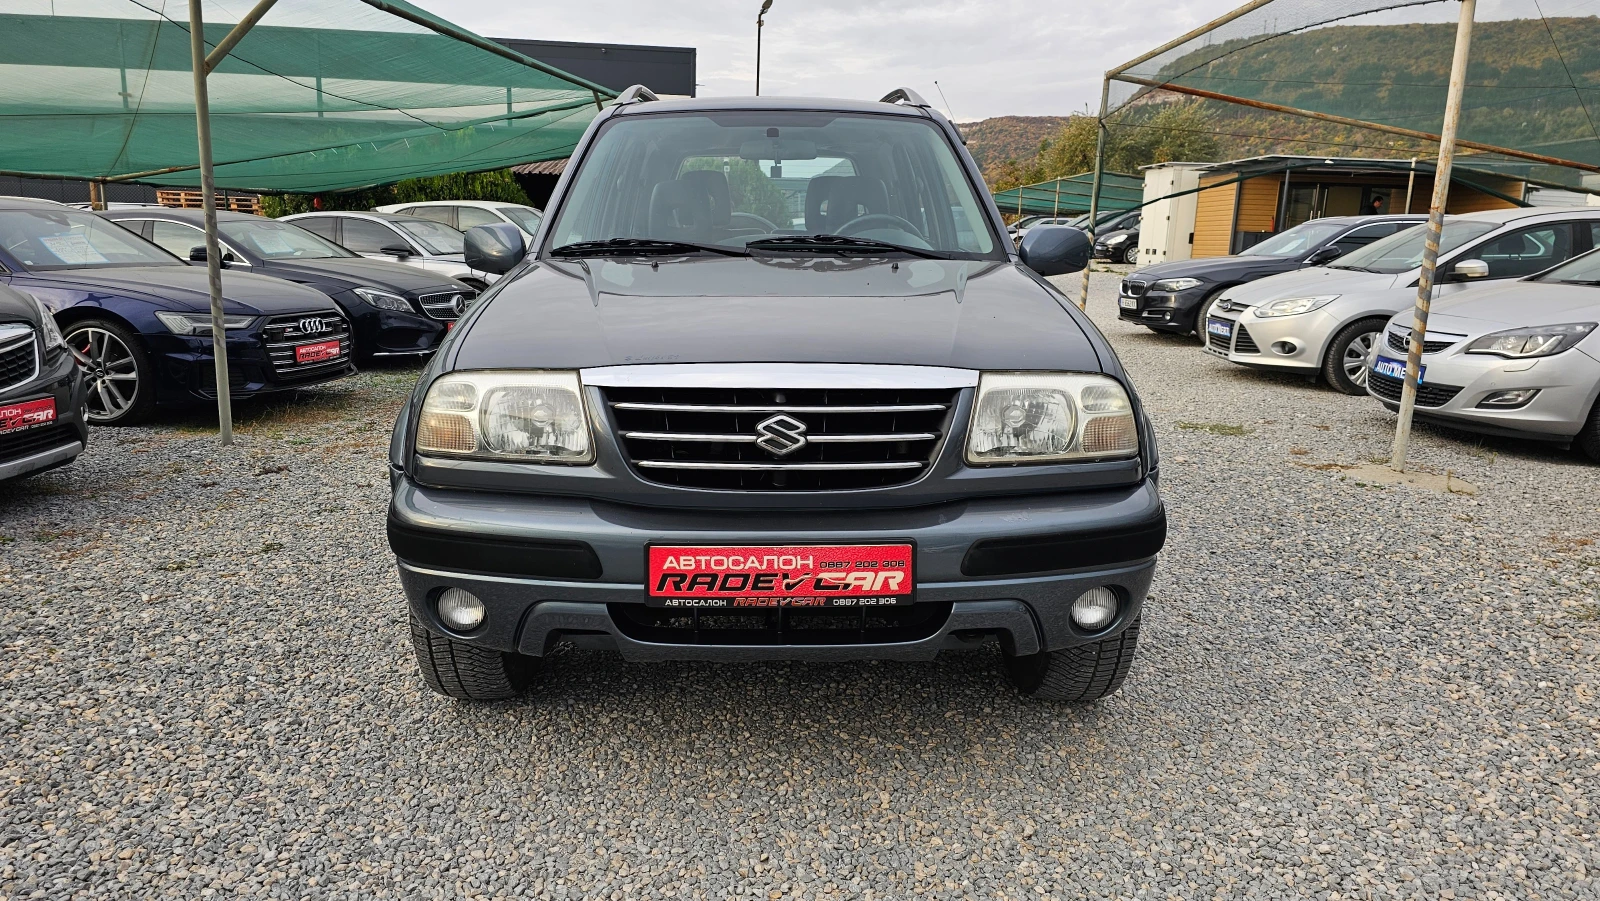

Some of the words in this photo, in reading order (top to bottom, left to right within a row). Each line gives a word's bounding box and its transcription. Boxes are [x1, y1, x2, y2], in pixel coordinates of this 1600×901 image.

[1376, 361, 1393, 376] AUTO
[662, 555, 814, 570] АВТОСАЛОН
[820, 561, 851, 569] 0887
[855, 560, 879, 568] 202
[665, 599, 727, 607] АВТОСАЛОН
[833, 598, 858, 606] 0887
